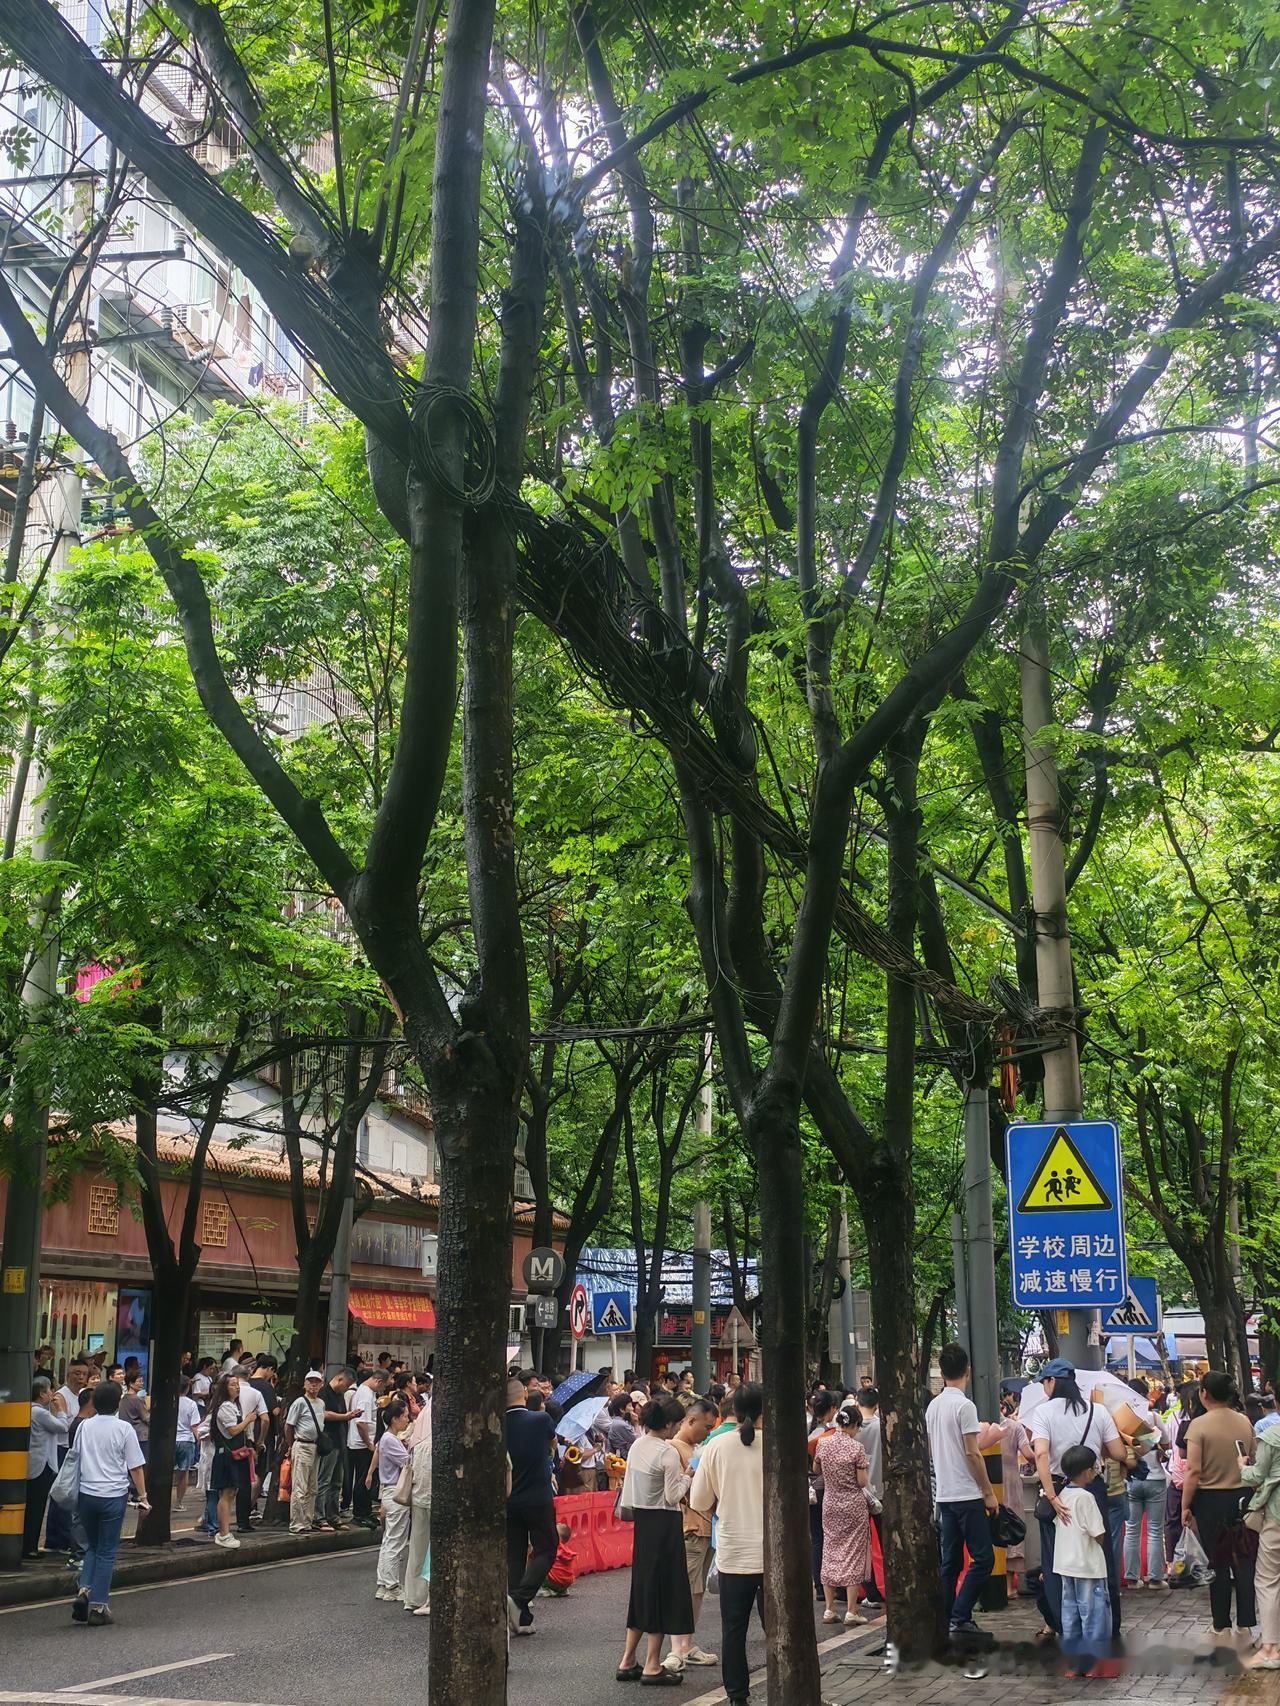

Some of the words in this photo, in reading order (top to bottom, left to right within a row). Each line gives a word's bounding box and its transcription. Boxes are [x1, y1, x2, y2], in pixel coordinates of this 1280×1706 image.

[1018, 1234, 1116, 1259] 学校周边
[531, 1257, 554, 1280] M
[1019, 1269, 1118, 1293] 减速慢行
